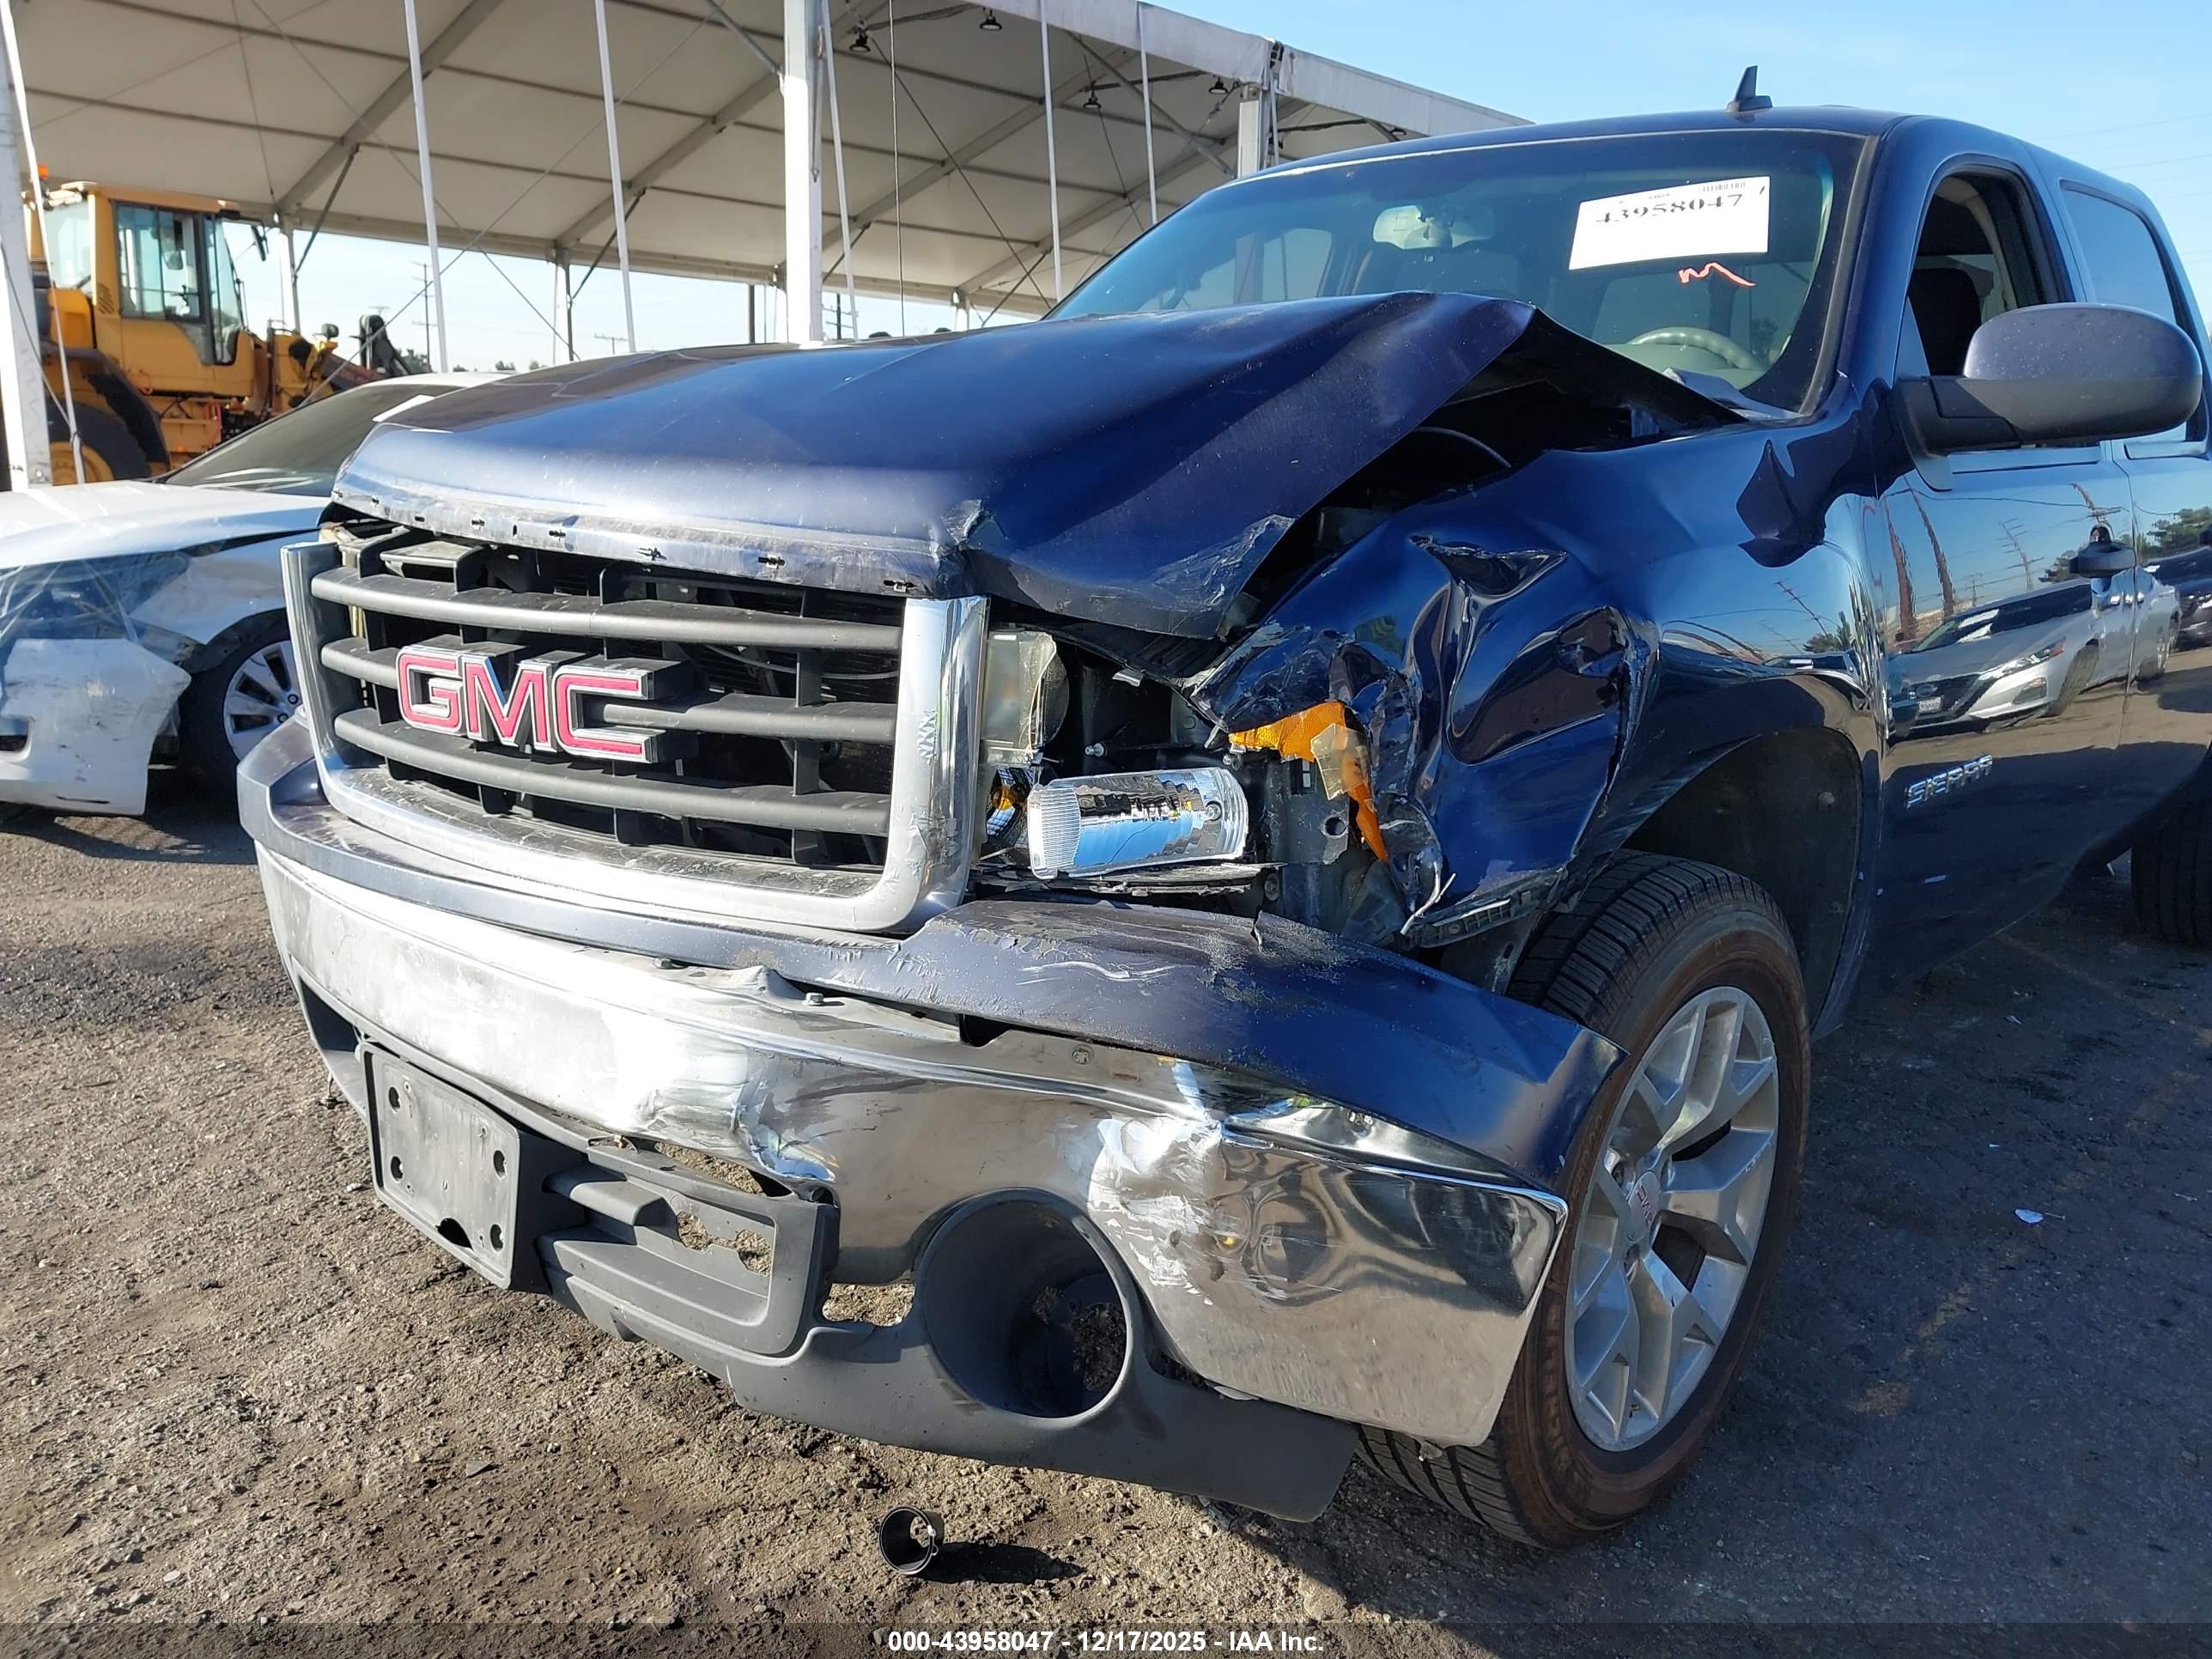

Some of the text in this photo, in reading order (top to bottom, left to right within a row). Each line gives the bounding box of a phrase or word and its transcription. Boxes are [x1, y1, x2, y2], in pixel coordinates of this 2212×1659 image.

[1595, 192, 1743, 224] 43958047
[395, 643, 658, 764] GMC
[1904, 755, 1993, 809] SIERRA
